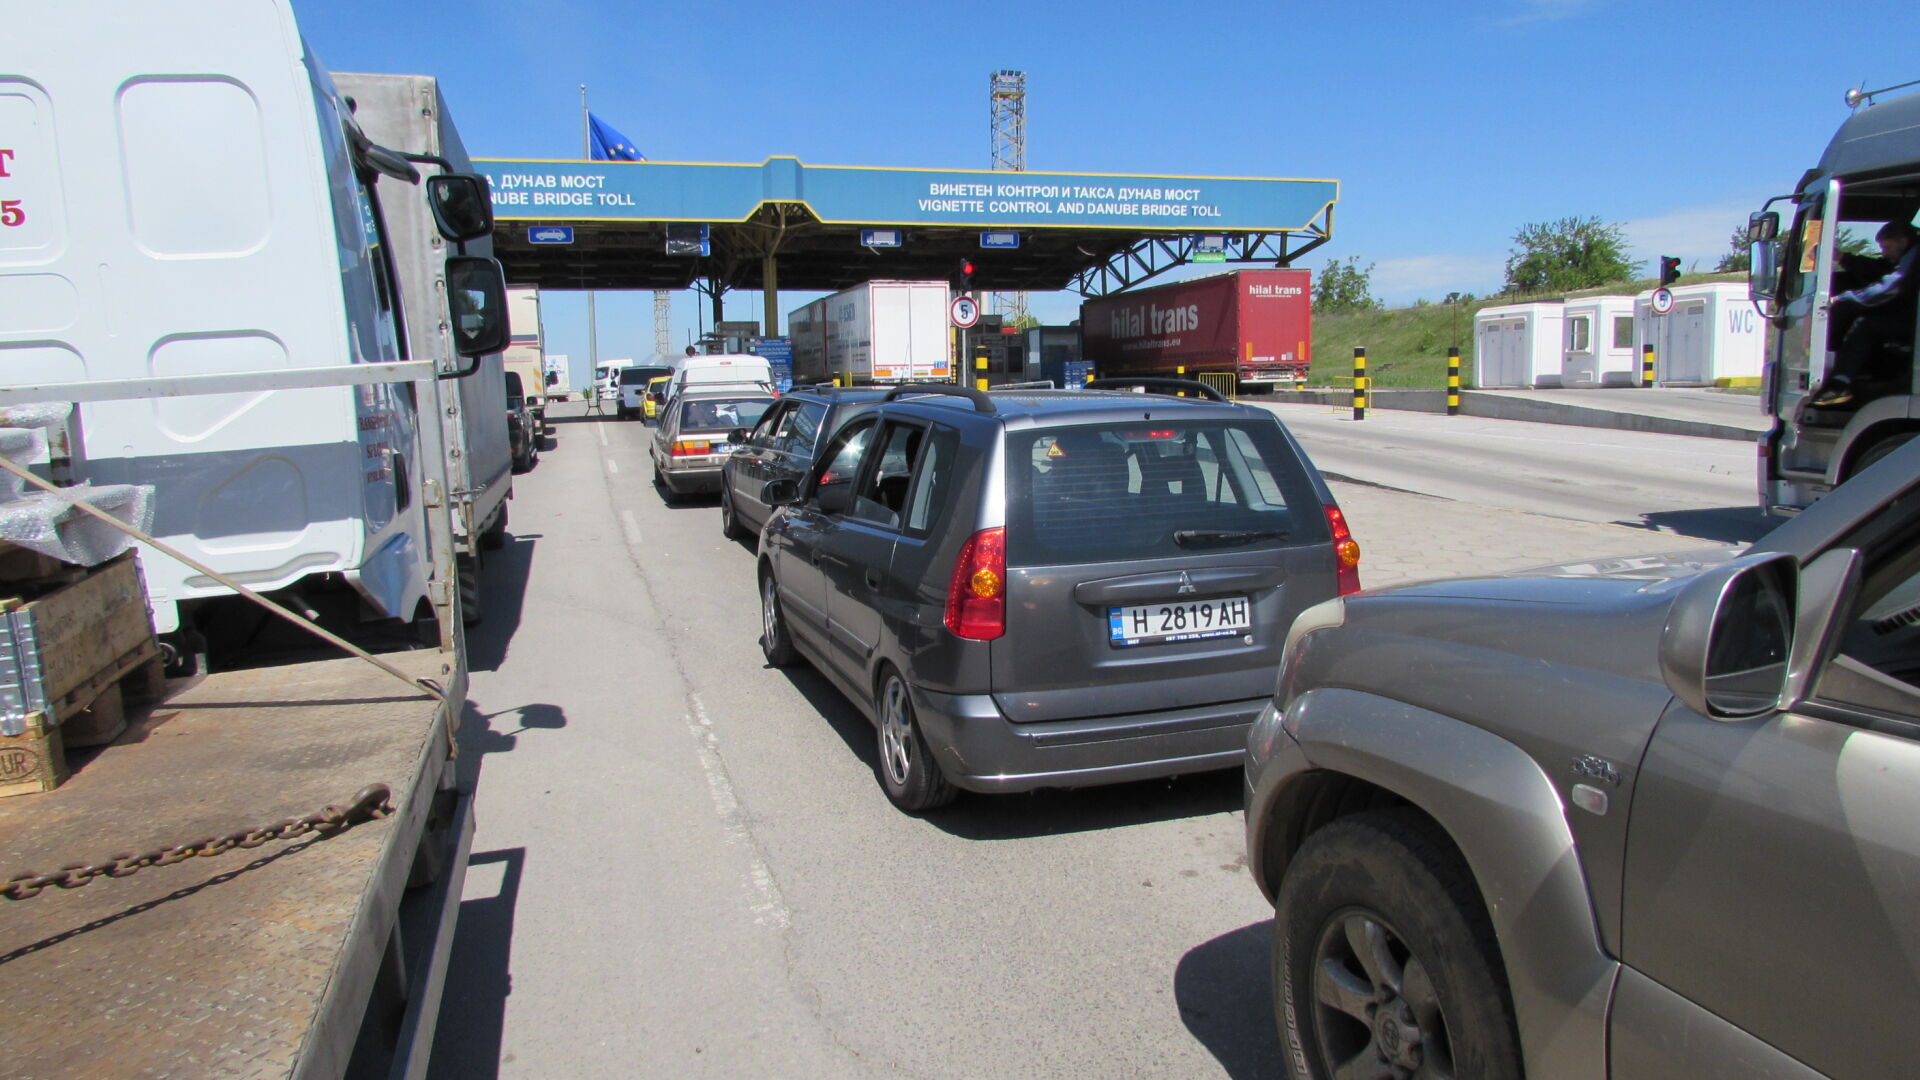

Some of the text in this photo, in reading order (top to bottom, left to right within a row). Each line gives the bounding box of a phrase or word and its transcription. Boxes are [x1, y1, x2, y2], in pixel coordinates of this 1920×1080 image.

[501, 174, 557, 189] ДУНАВ
[561, 175, 605, 188] МОСТ
[534, 193, 593, 206] BRIDGE
[597, 193, 636, 206] TOLL
[930, 183, 1201, 201] ВИНЕТЕН КОНТРОЛ И ТАКСА ДУНАВ МОСТ
[918, 199, 1222, 217] VIGNETTE CONTROL AND DANUBE BRIDGE TOLL
[1249, 284, 1302, 295] hilal trans
[960, 304, 969, 320] 5
[1111, 303, 1199, 339] hilal trans
[1729, 309, 1753, 334] WC
[1133, 600, 1246, 634] H 2819 AH
[1112, 626, 1123, 636] BG
[0, 753, 27, 775] UR
